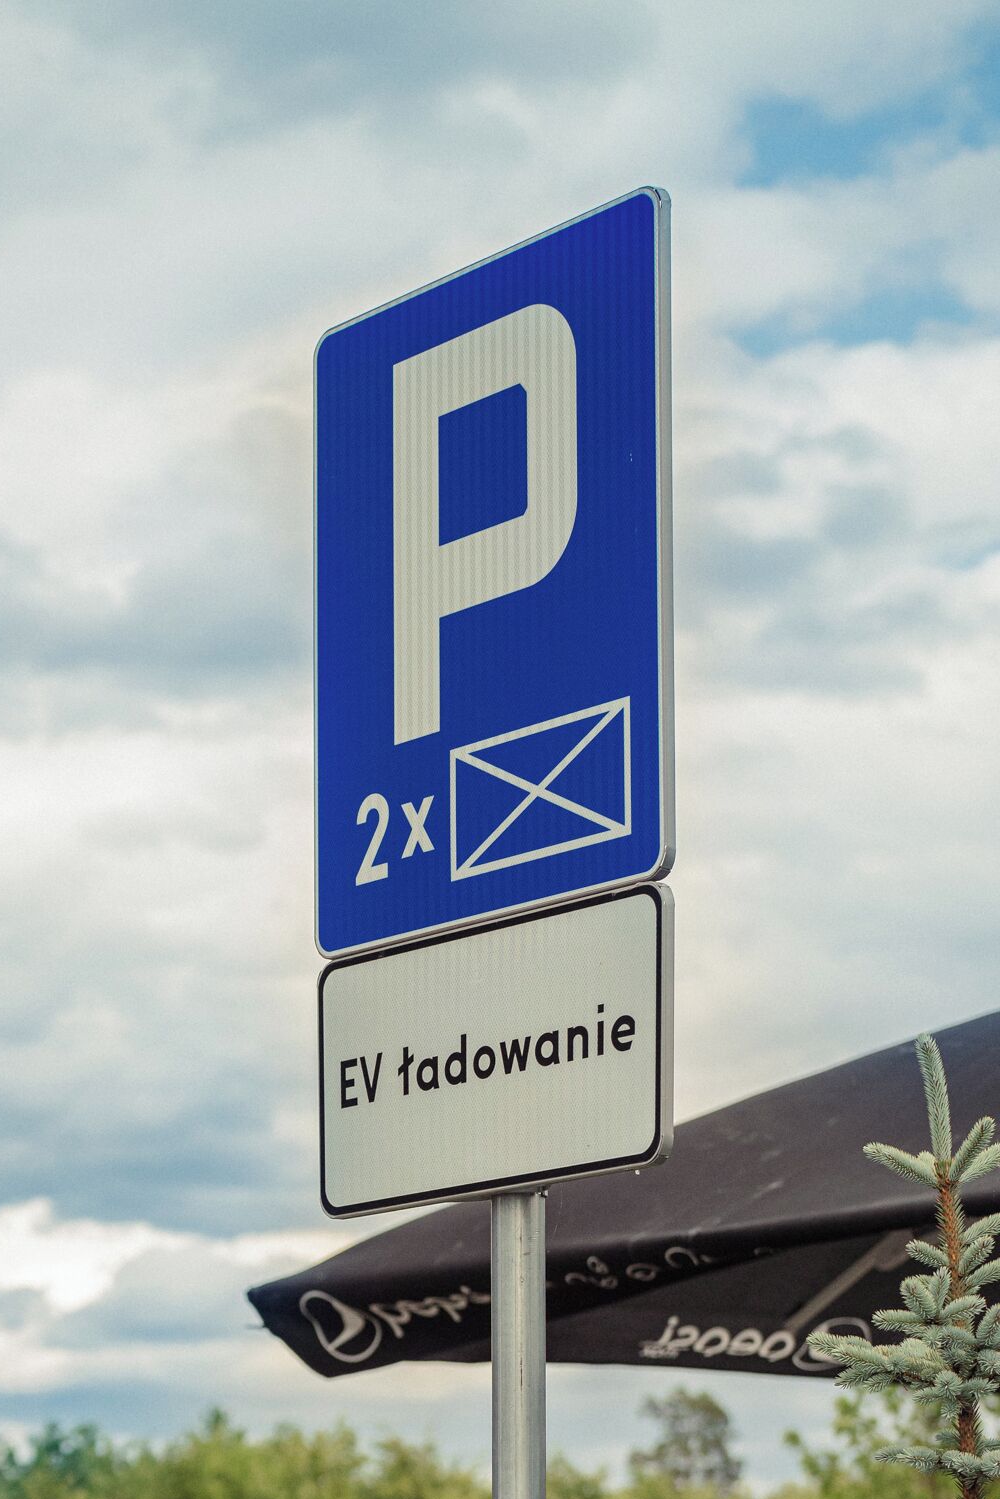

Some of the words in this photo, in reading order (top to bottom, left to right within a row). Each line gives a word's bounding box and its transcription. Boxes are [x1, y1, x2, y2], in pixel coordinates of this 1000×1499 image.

[393, 303, 577, 746] P
[340, 1052, 383, 1109] EV
[397, 1003, 636, 1096] ładowanie
